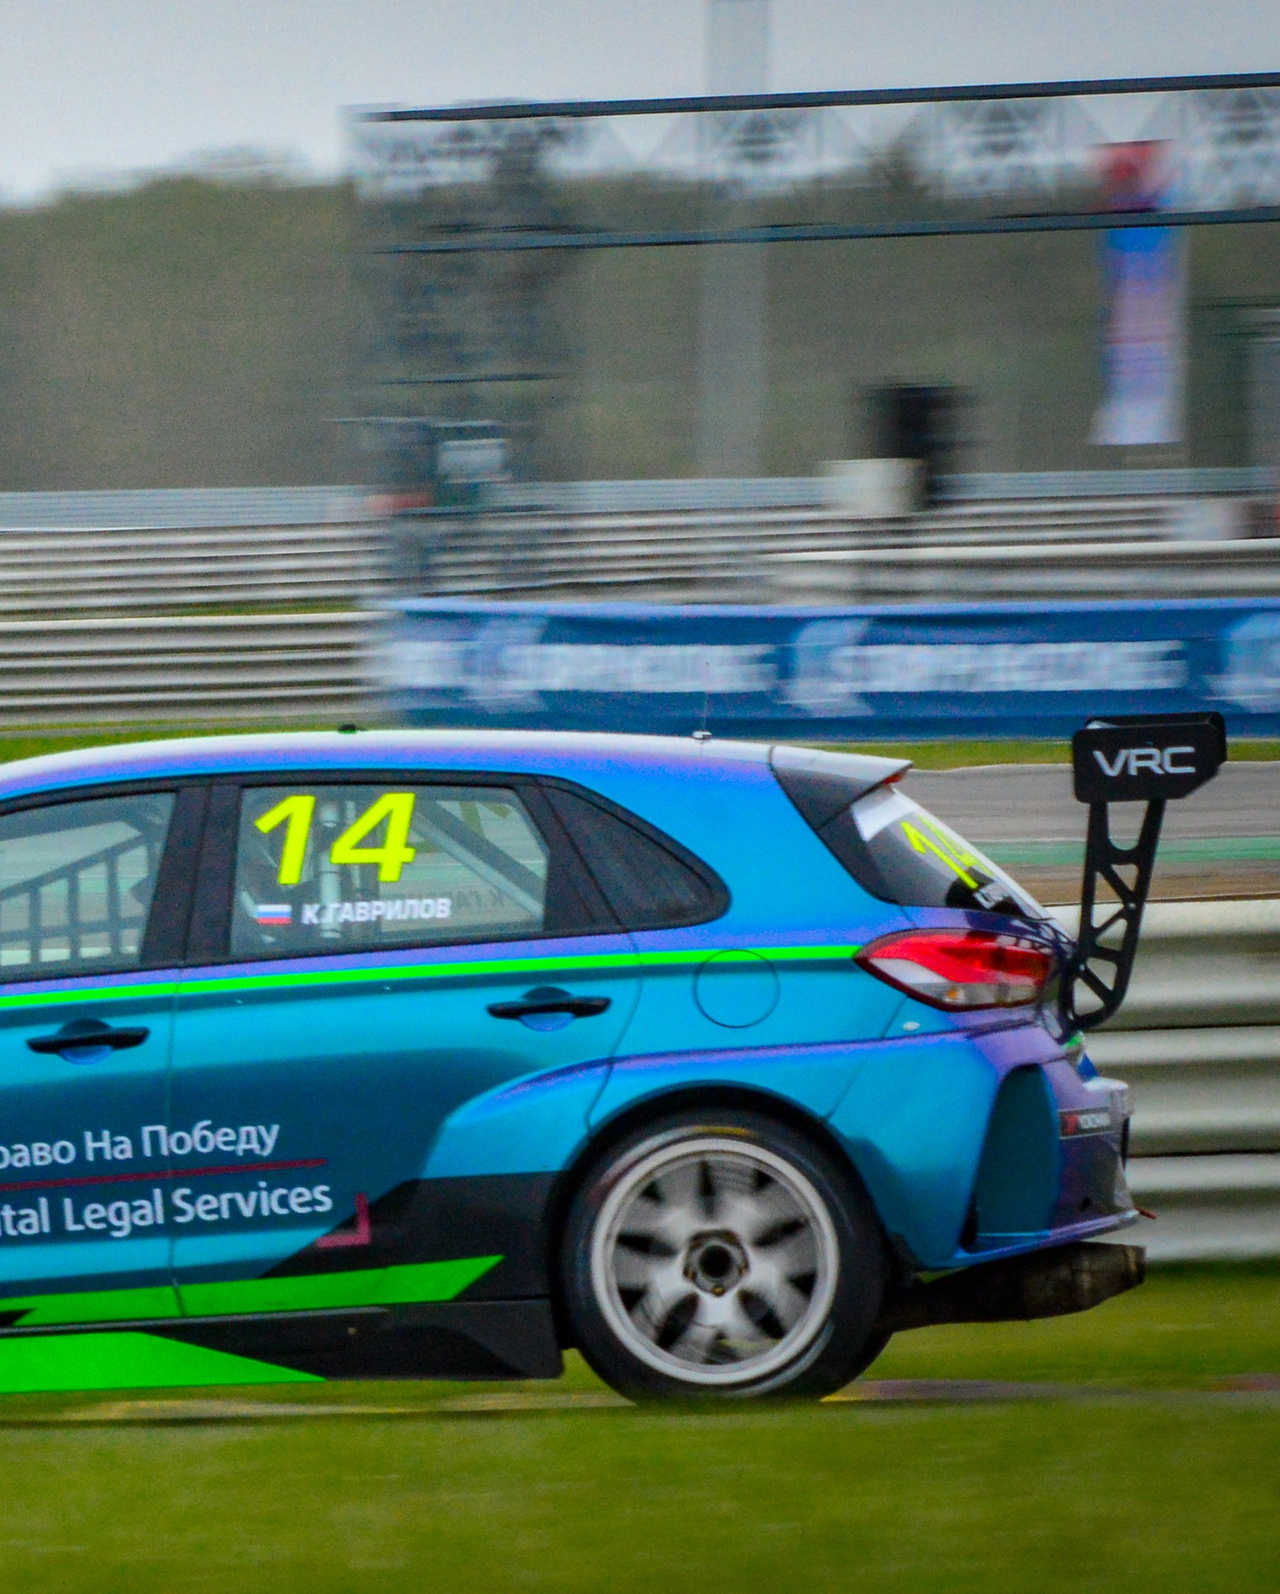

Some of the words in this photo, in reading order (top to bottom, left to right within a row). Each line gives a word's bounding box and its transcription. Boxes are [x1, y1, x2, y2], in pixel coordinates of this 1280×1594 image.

[1092, 745, 1196, 777] VRC
[254, 792, 417, 885] 14
[300, 897, 452, 925] К.ГАВРИЛОВ
[84, 1130, 134, 1161] На
[141, 1120, 280, 1157] Победу
[64, 1188, 165, 1238] Legal
[171, 1181, 334, 1223] Services
